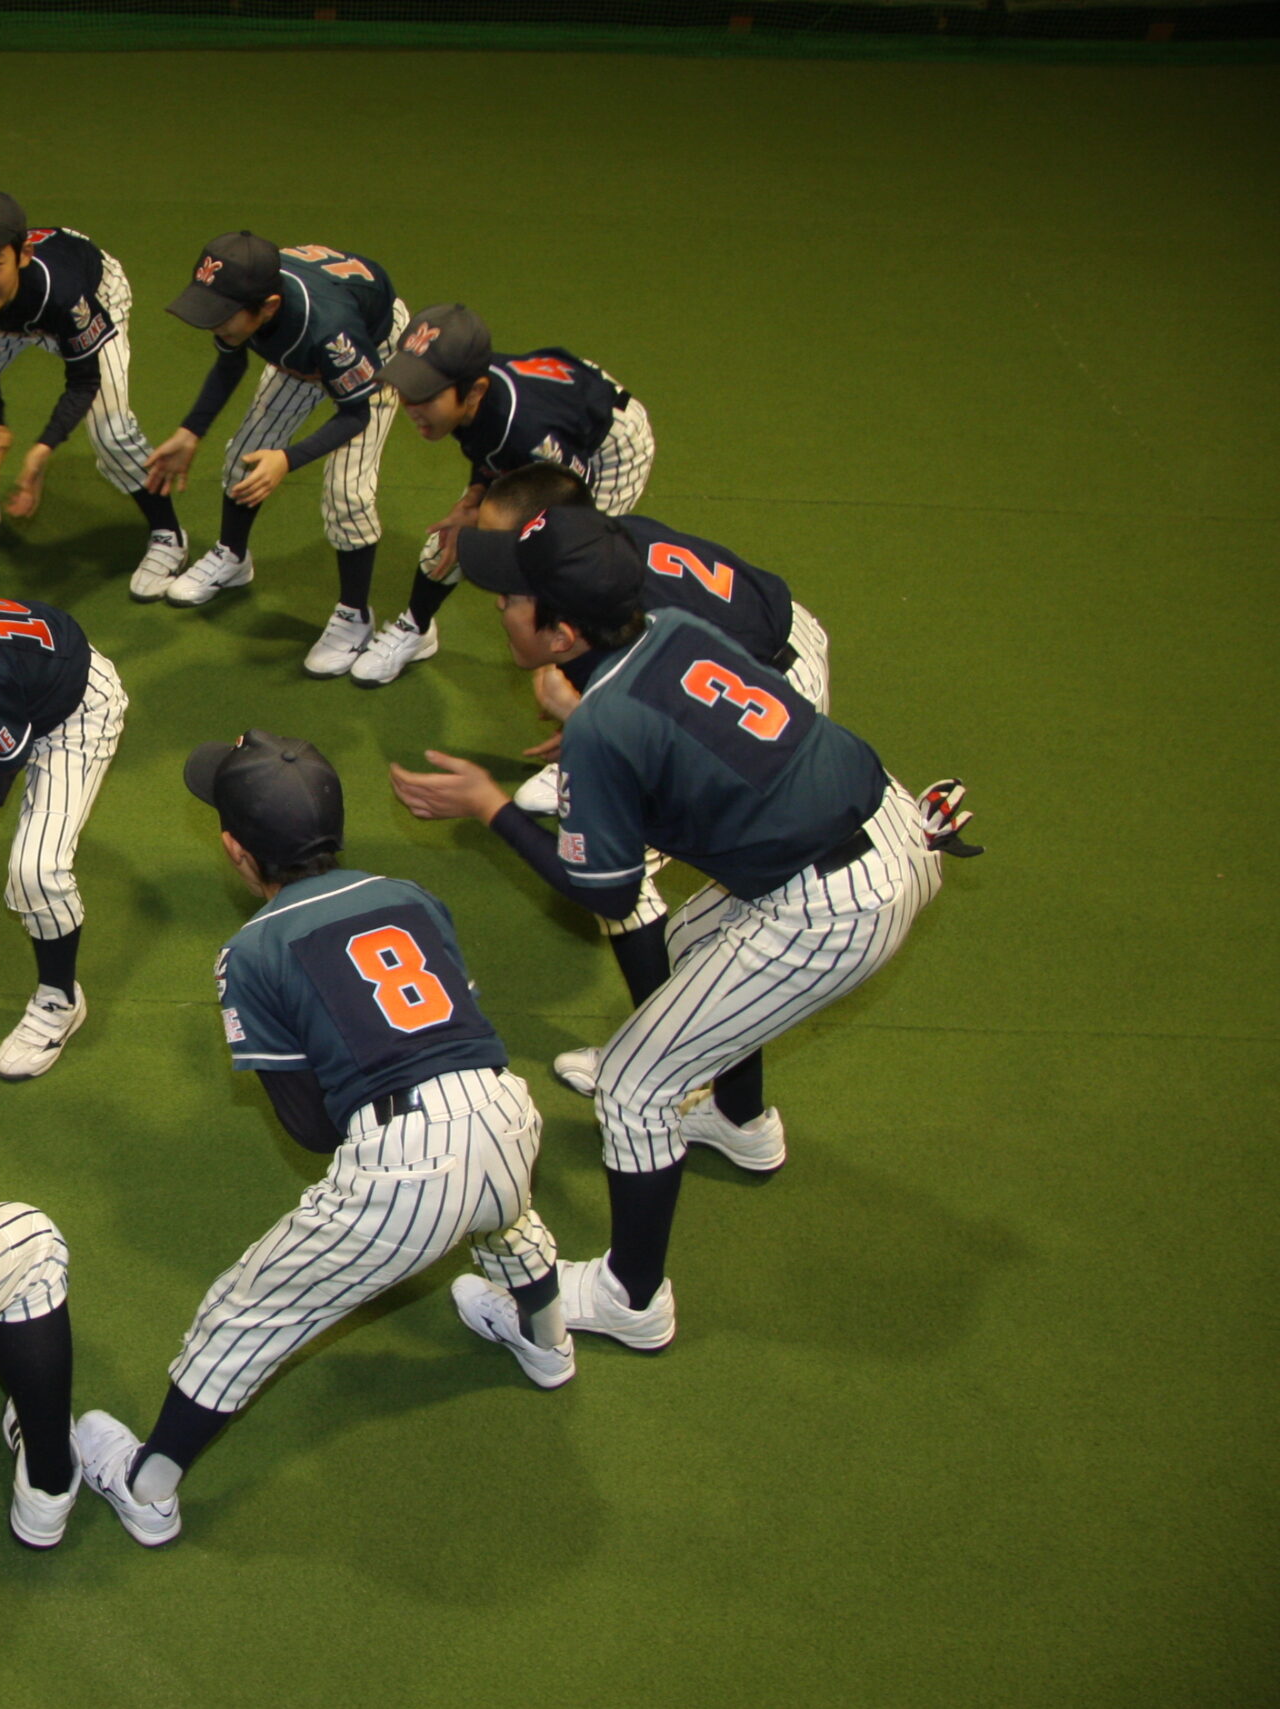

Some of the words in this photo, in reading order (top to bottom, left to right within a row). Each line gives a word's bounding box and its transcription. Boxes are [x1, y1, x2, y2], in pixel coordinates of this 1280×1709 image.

[67, 312, 109, 353] TEINE
[506, 356, 575, 385] 4
[646, 539, 737, 602] 2
[681, 658, 793, 742] 3
[346, 924, 454, 1034] 8
